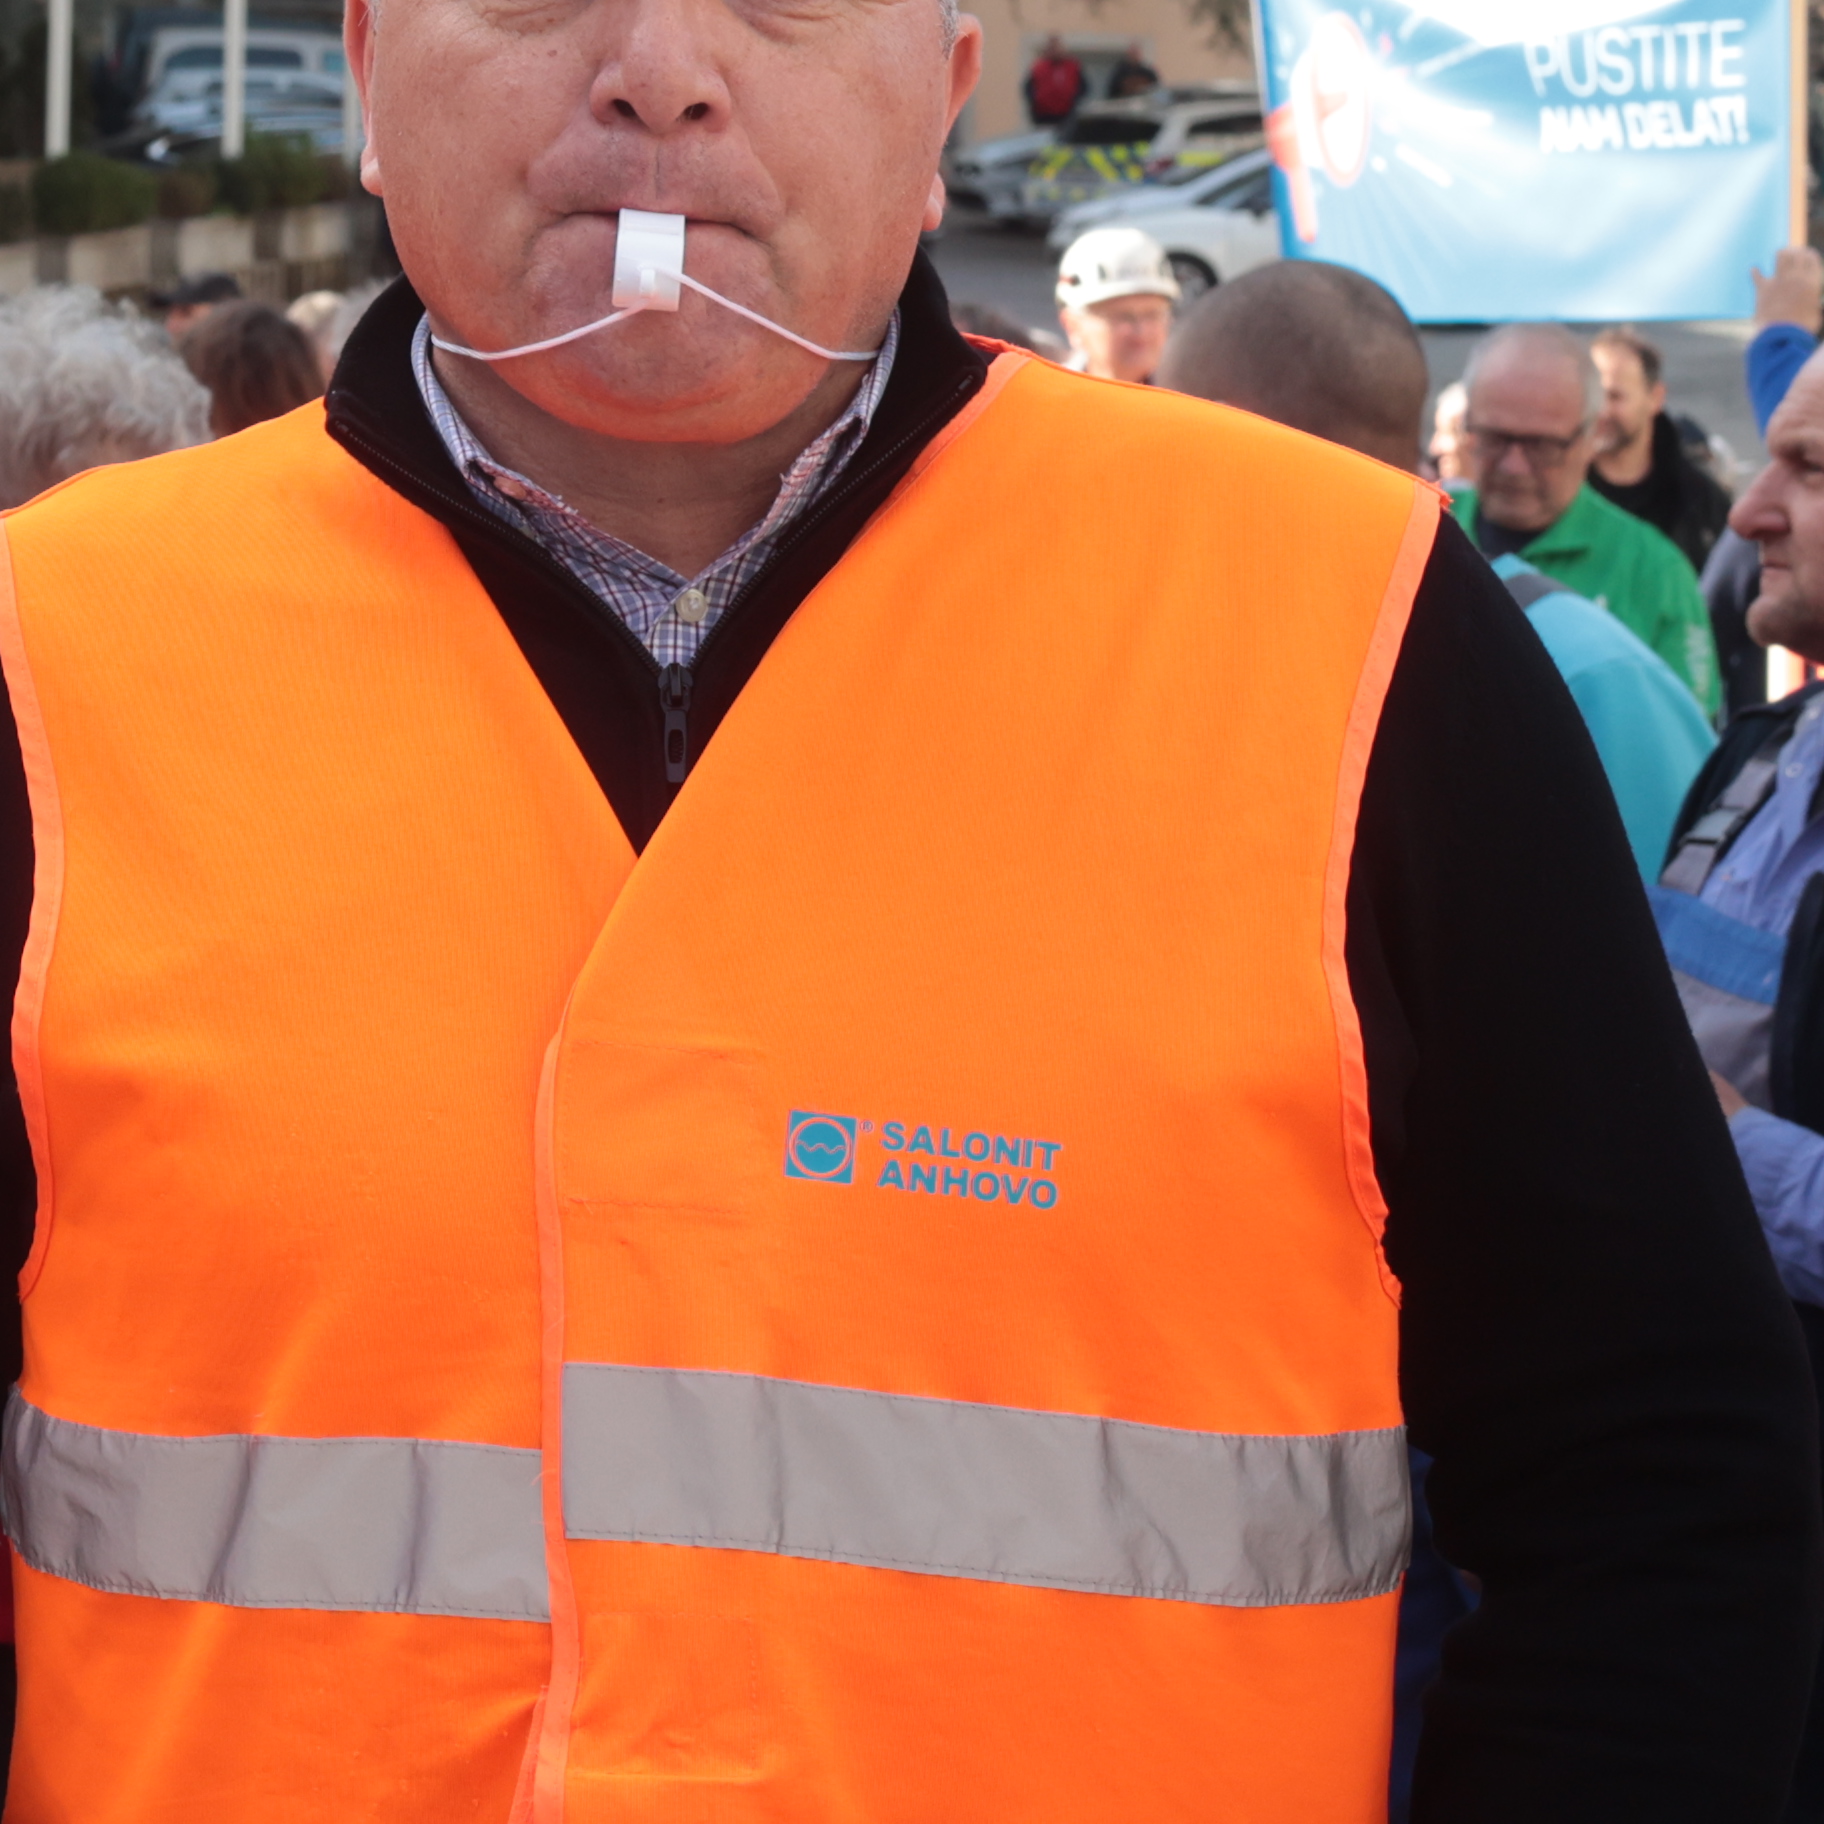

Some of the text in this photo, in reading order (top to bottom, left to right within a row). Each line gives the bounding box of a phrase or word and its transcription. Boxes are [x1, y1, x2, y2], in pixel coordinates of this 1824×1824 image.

[1525, 19, 1746, 97] PUSTITE
[1539, 102, 1624, 154] NAM
[882, 1122, 1061, 1170] SALONIT
[878, 1160, 1058, 1209] ANHOVO
